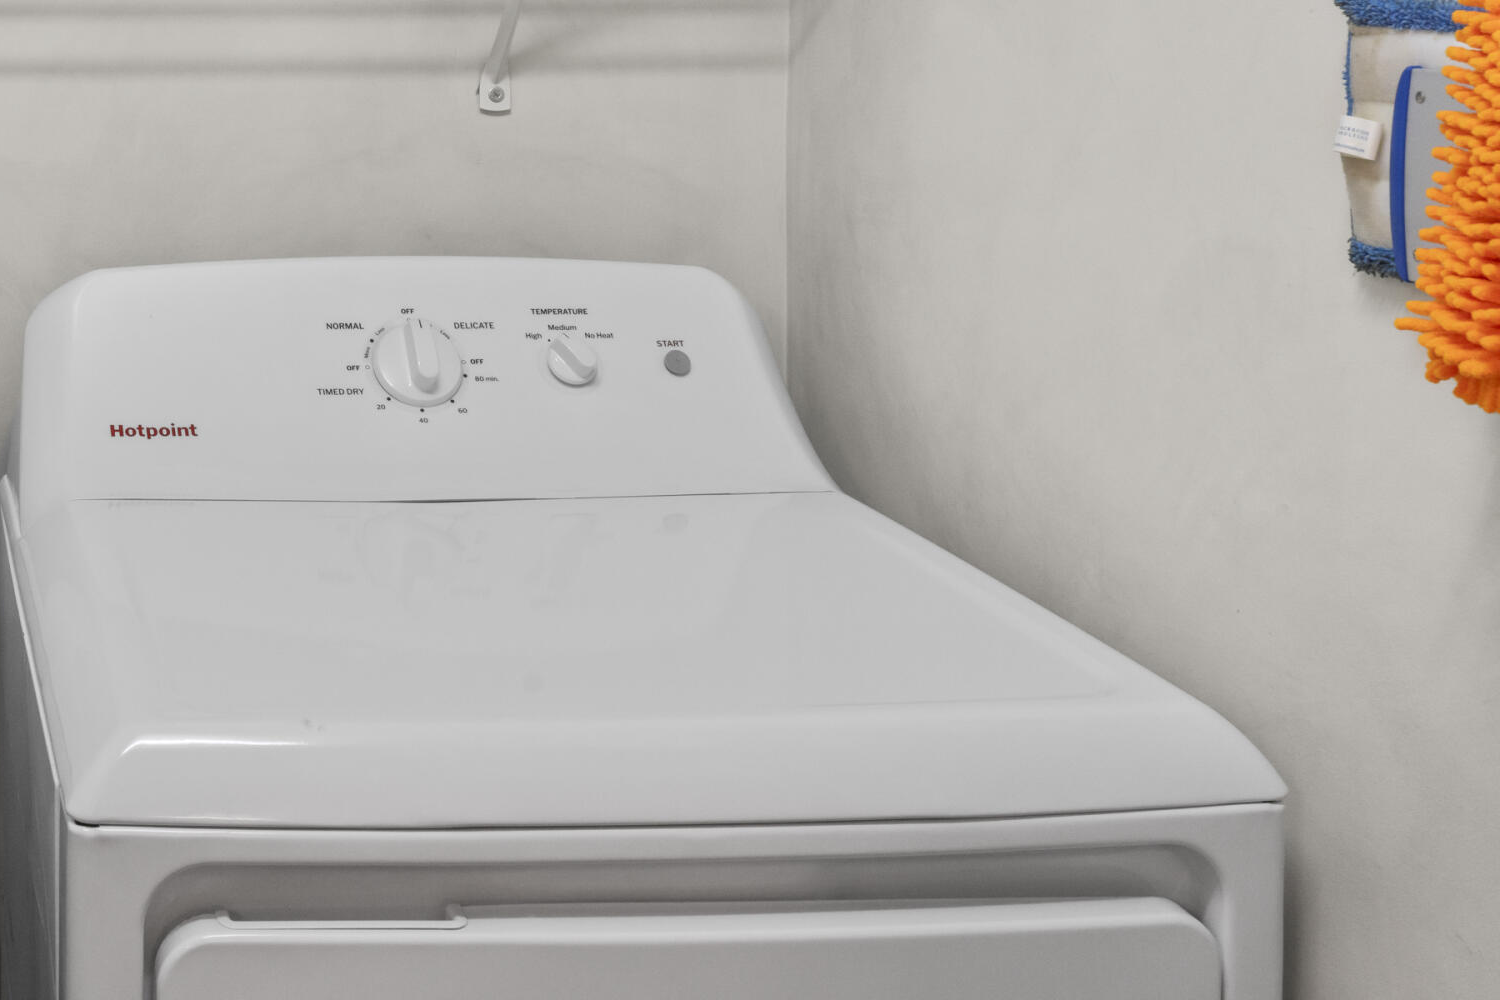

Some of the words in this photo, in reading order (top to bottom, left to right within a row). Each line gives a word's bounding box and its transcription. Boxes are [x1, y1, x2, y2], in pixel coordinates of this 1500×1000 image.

[326, 322, 364, 330] NORMAL
[453, 321, 495, 329] DELICATE
[525, 332, 543, 340] High
[656, 340, 685, 348] START
[317, 388, 345, 396] TIMED
[347, 388, 364, 396] DRY
[109, 422, 199, 440] Hotpoint
